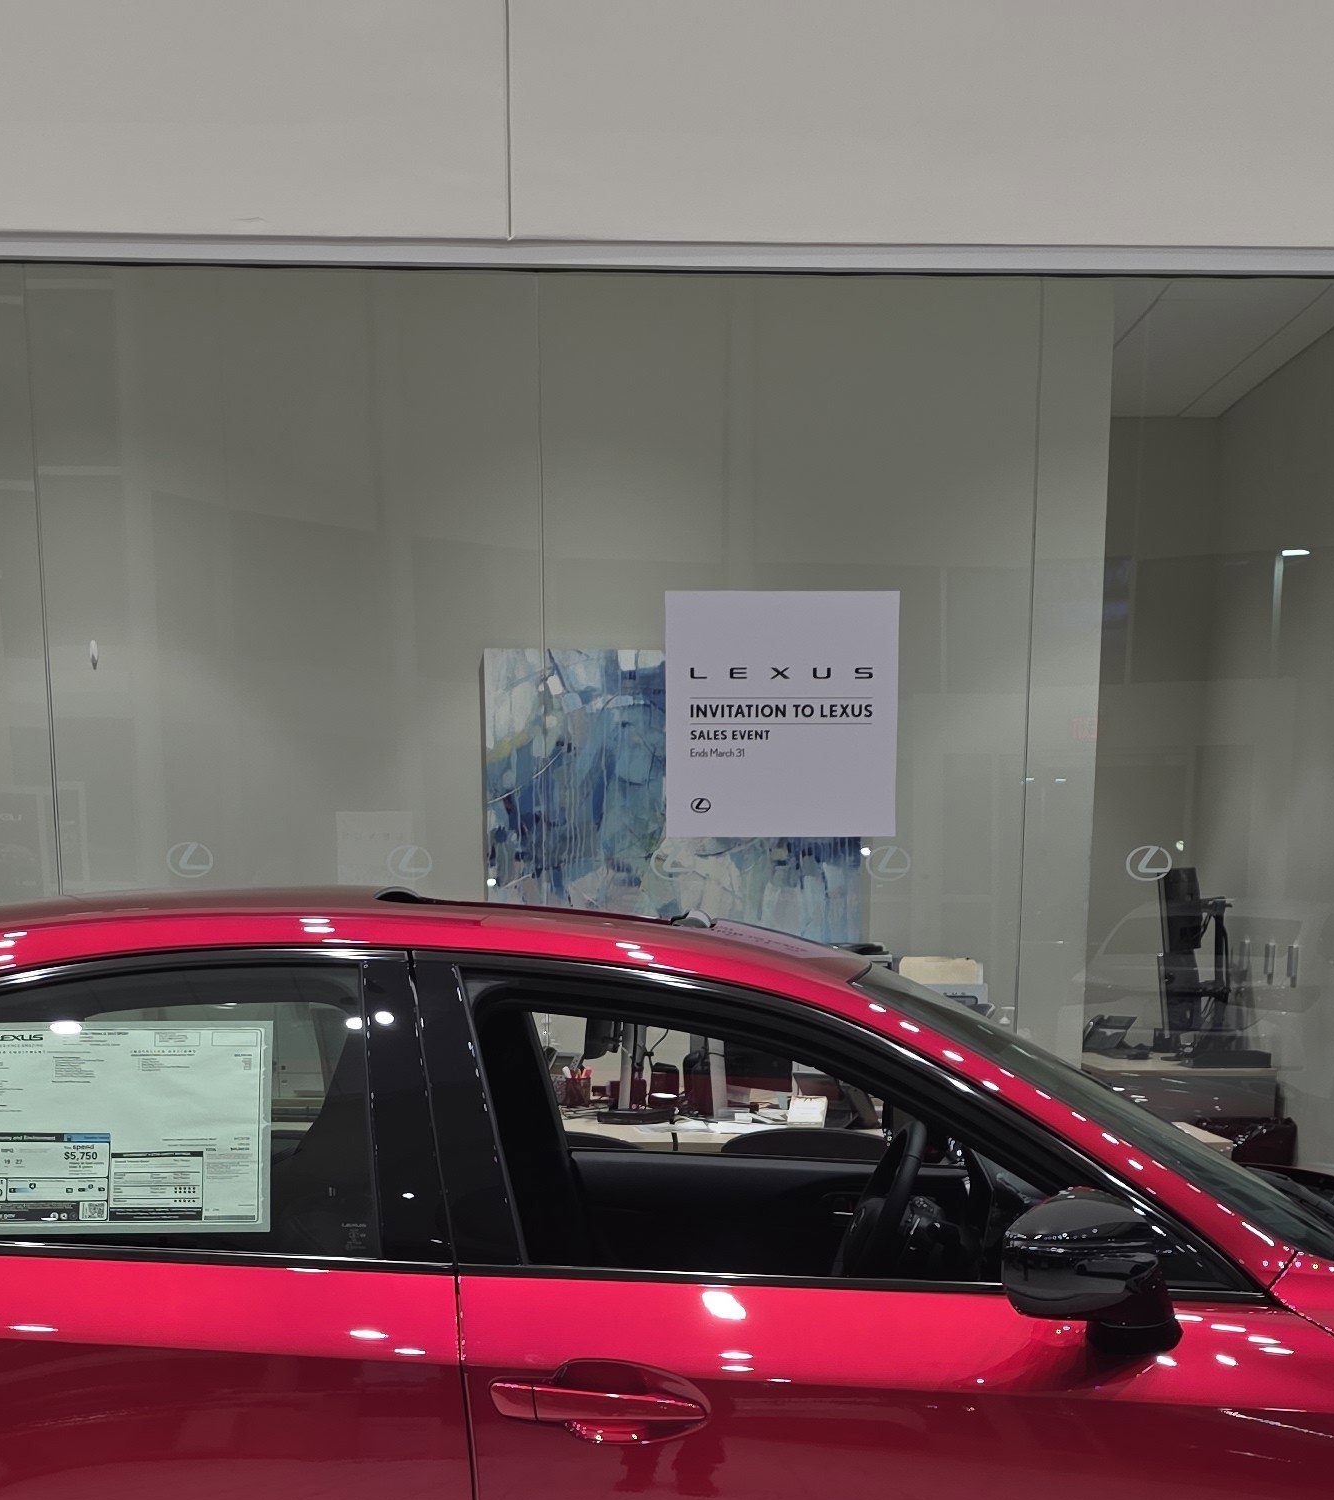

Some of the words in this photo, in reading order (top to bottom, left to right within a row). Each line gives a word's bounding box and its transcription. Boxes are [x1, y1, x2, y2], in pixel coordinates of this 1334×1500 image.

[689, 666, 874, 680] LEXUS
[689, 703, 787, 718] INVITATION
[792, 703, 815, 718] TO
[819, 703, 873, 718] LEXUS
[690, 729, 728, 741] SALES
[731, 729, 771, 741] EVENT
[689, 748, 709, 758] Ends
[710, 748, 735, 758] March
[735, 748, 746, 758] 31
[63, 1151, 98, 1162] $5,750
